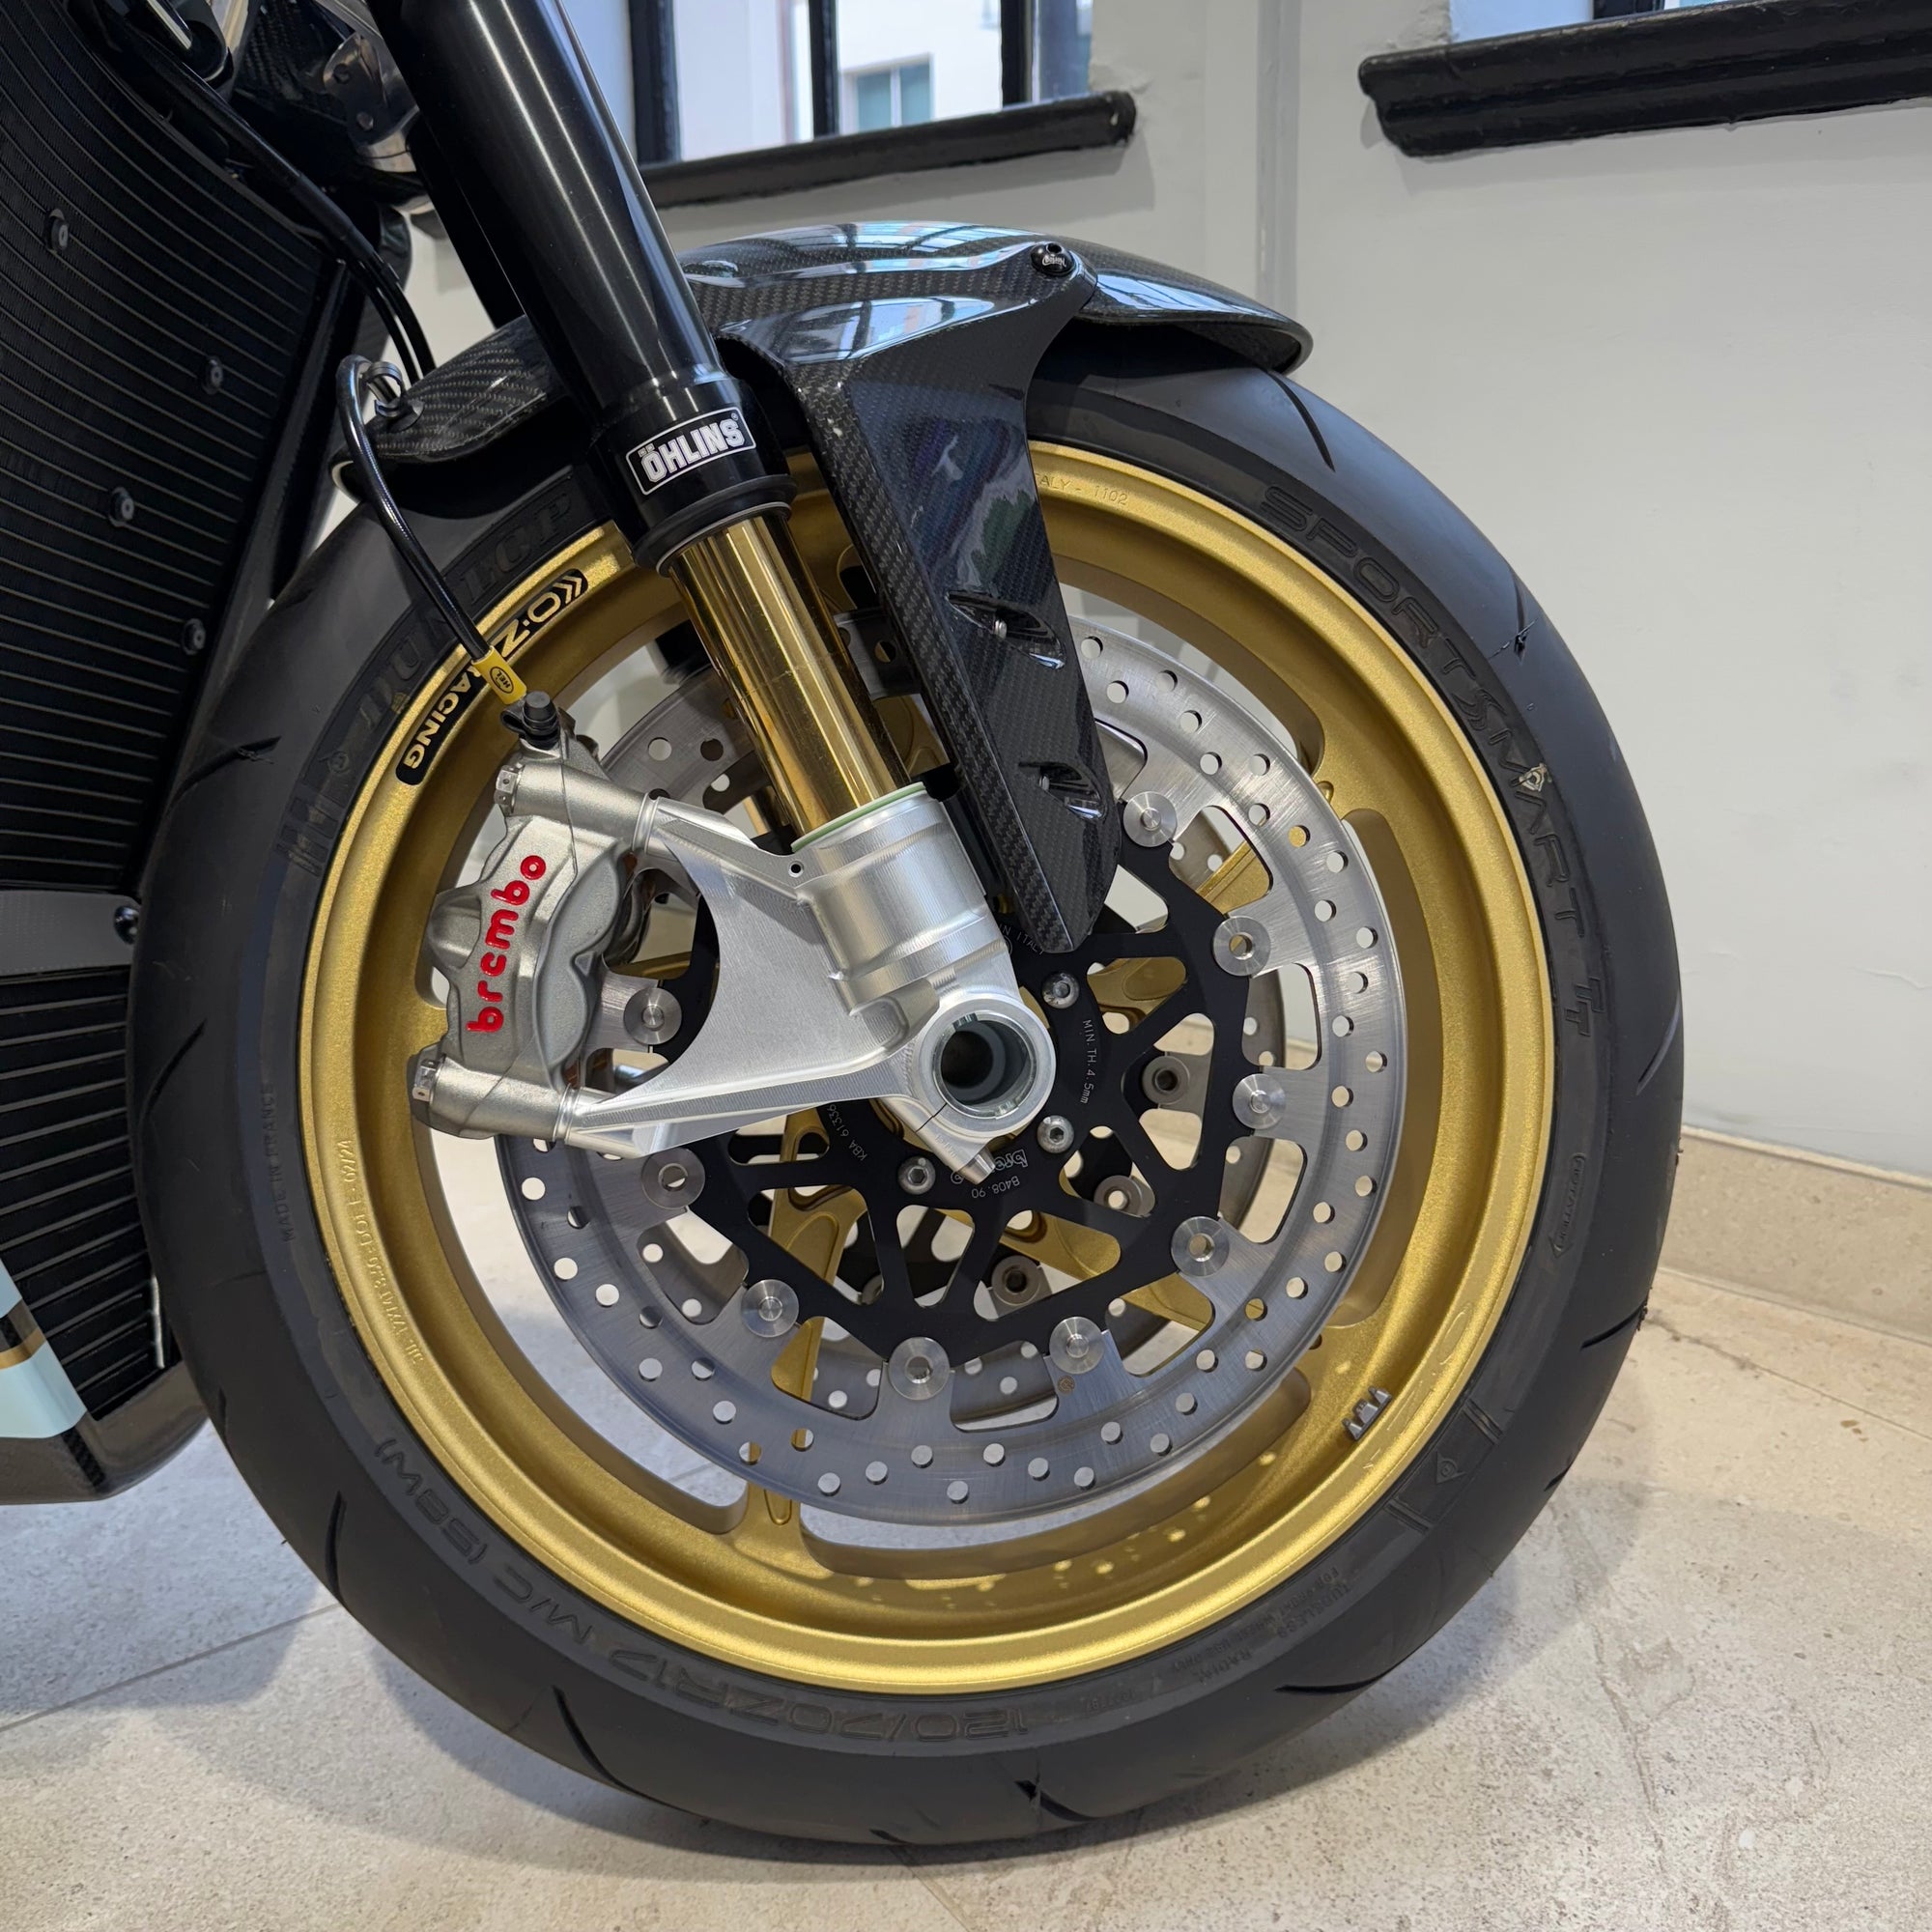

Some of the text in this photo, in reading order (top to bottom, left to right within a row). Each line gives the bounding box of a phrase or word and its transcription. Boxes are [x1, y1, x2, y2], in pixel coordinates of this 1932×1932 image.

[638, 418, 745, 483] ÖHLINS
[1094, 485, 1127, 505] 1102
[496, 669, 511, 689] HEL
[466, 854, 547, 1034] brembo
[336, 1138, 358, 1183] 02/24
[848, 1139, 867, 1161] KBA
